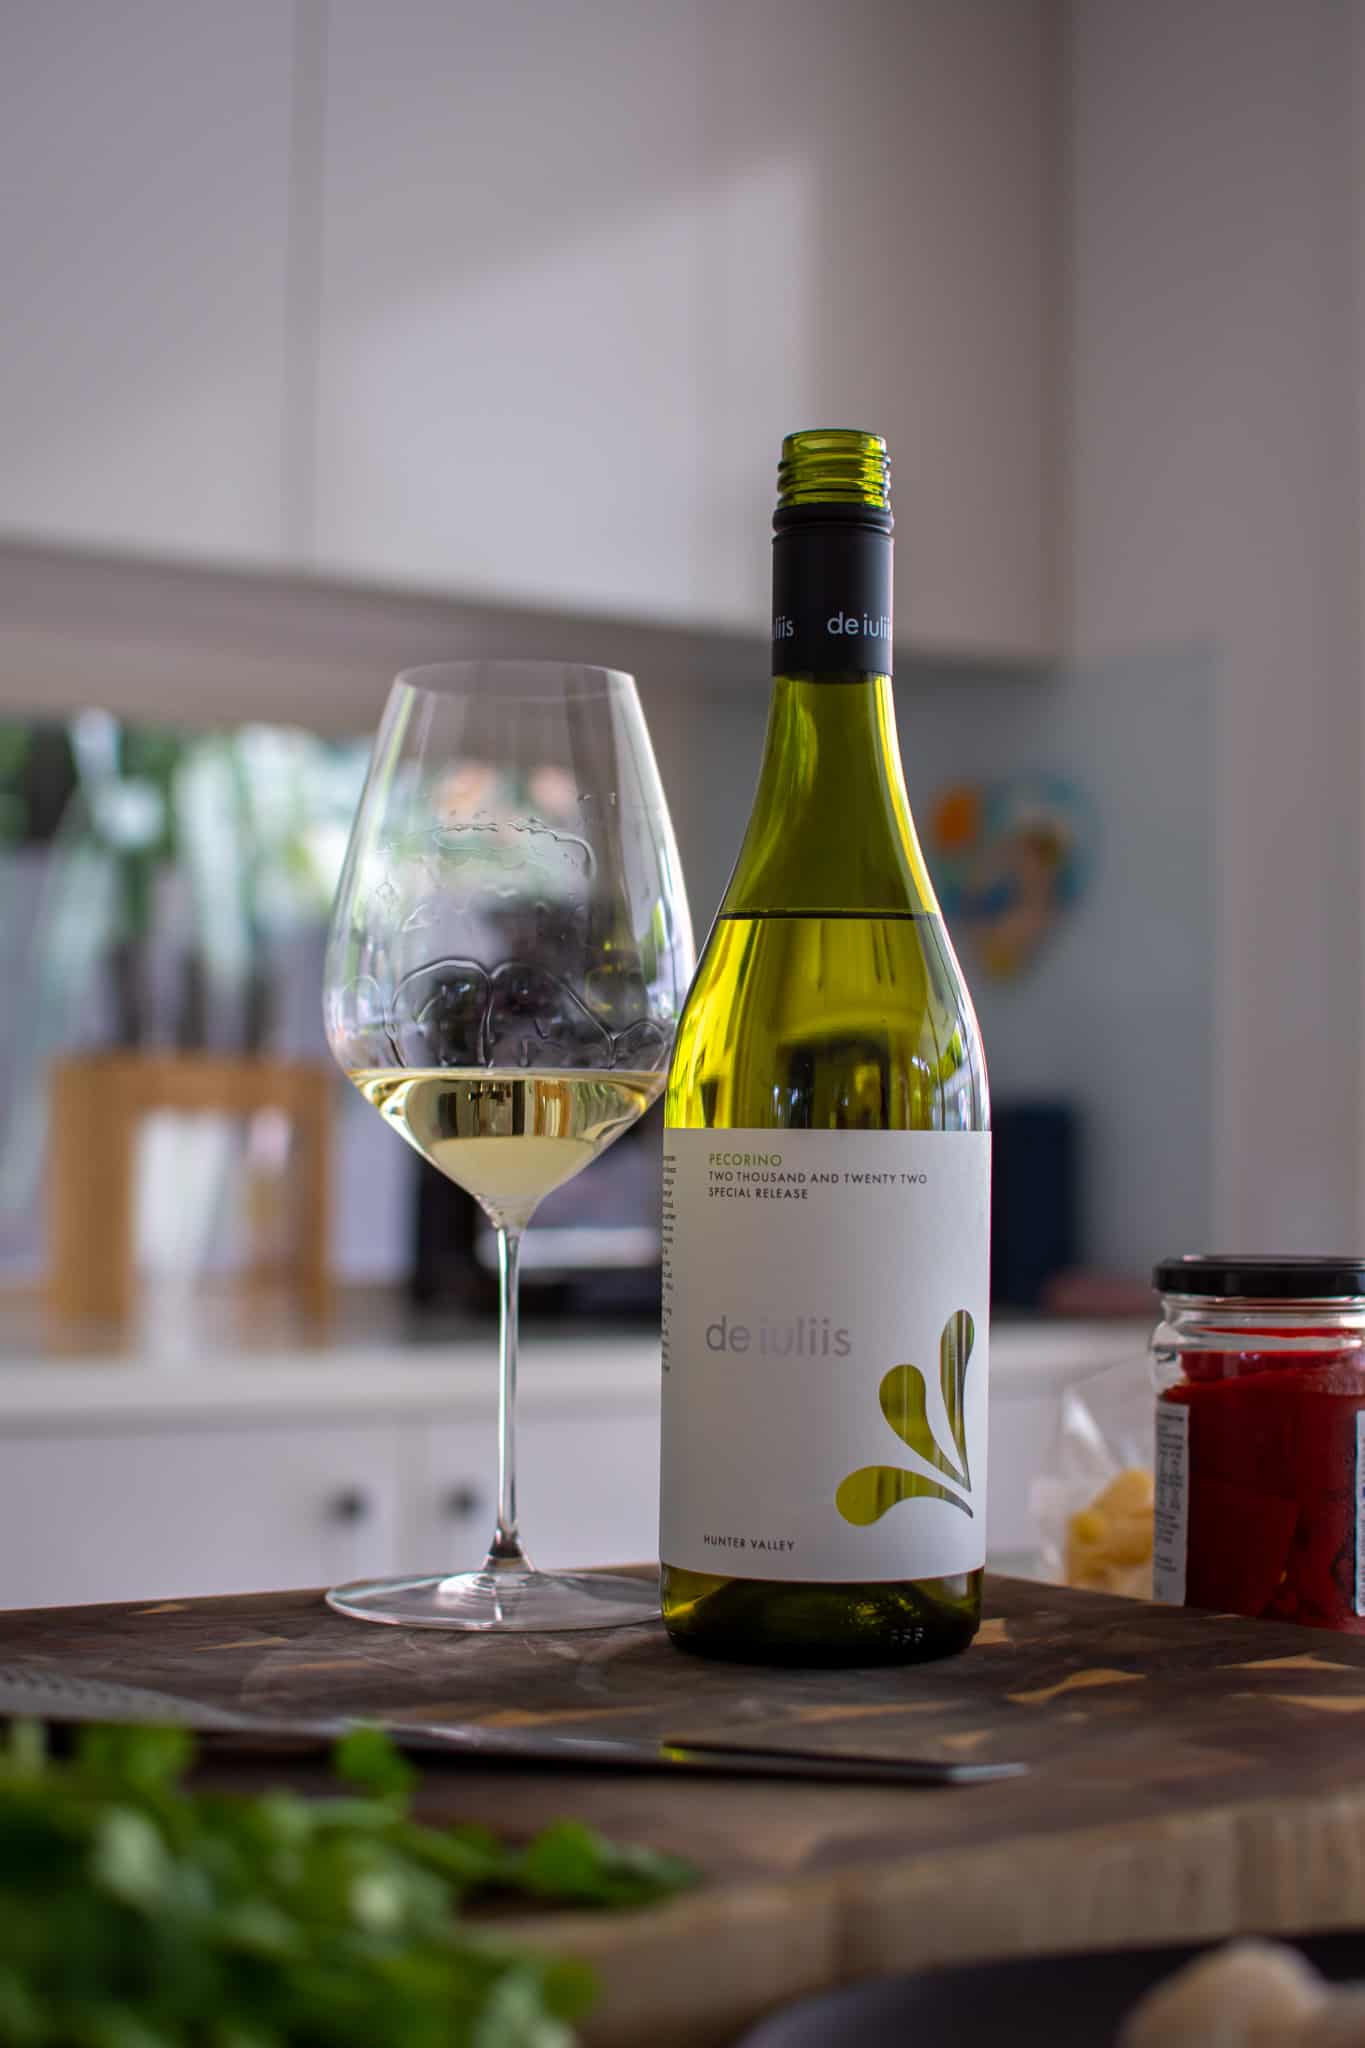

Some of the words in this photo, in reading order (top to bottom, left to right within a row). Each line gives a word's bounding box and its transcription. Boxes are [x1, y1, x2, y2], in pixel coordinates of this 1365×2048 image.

[827, 611, 859, 635] de
[708, 1153, 783, 1167] PECORINO
[708, 1171, 734, 1182] TWO
[737, 1172, 807, 1184] THOUSAND
[810, 1174, 840, 1185] AND
[844, 1173, 897, 1185] TWENTY
[900, 1174, 928, 1185] TWO
[708, 1187, 752, 1198] SPECIAL
[755, 1188, 809, 1200] RELEASE
[705, 1314, 751, 1352] de
[758, 1315, 851, 1358] iuliis
[703, 1535, 746, 1549] HUNTER
[749, 1538, 796, 1552] VALLEY
